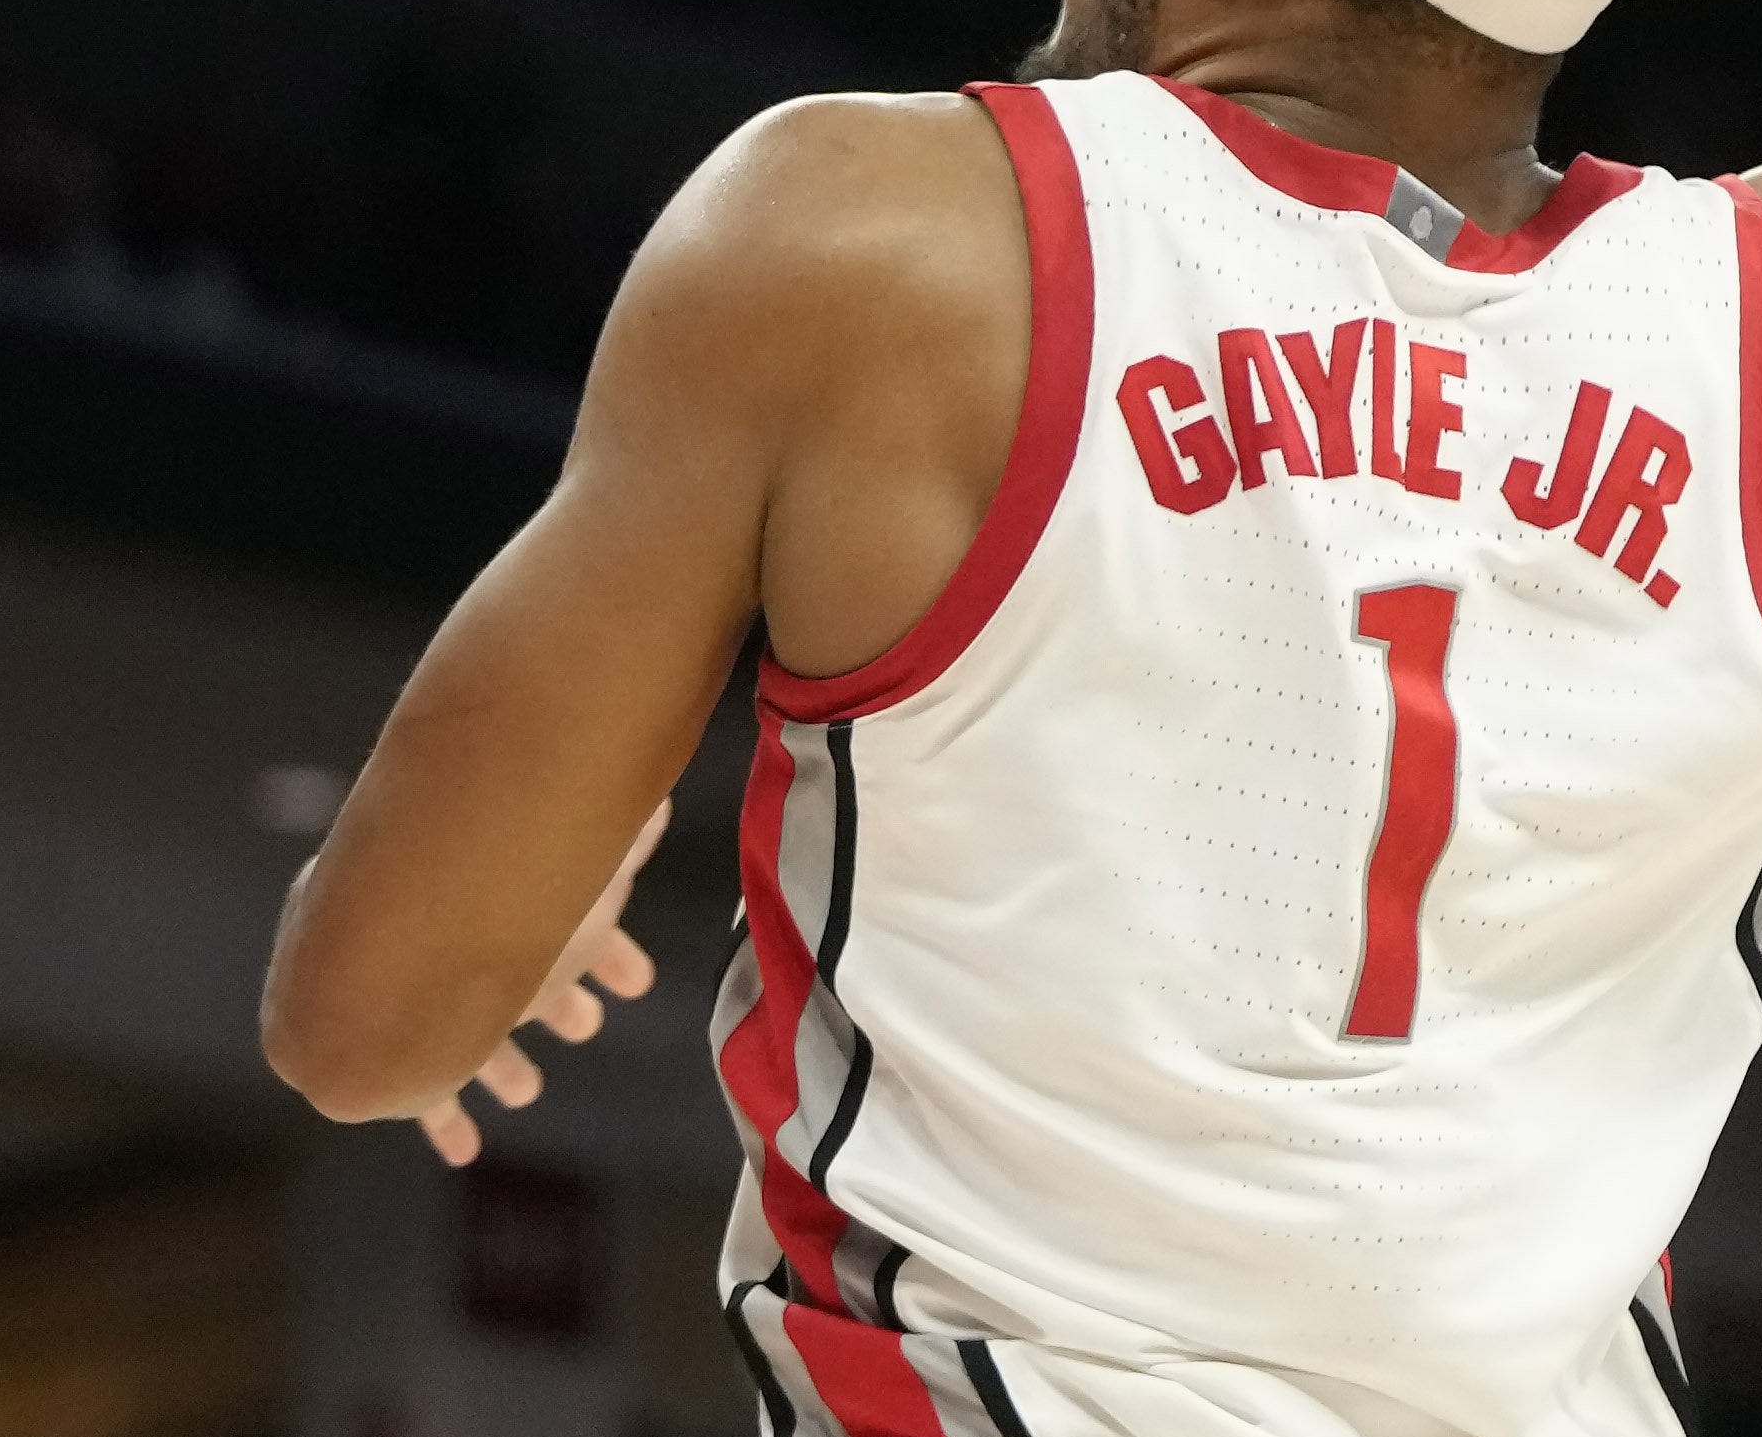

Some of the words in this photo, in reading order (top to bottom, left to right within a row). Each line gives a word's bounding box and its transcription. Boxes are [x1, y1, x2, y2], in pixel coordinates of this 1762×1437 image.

[1115, 316, 1467, 516] GAYLE
[1500, 378, 1694, 611] JR.
[1337, 577, 1463, 1045] 1
